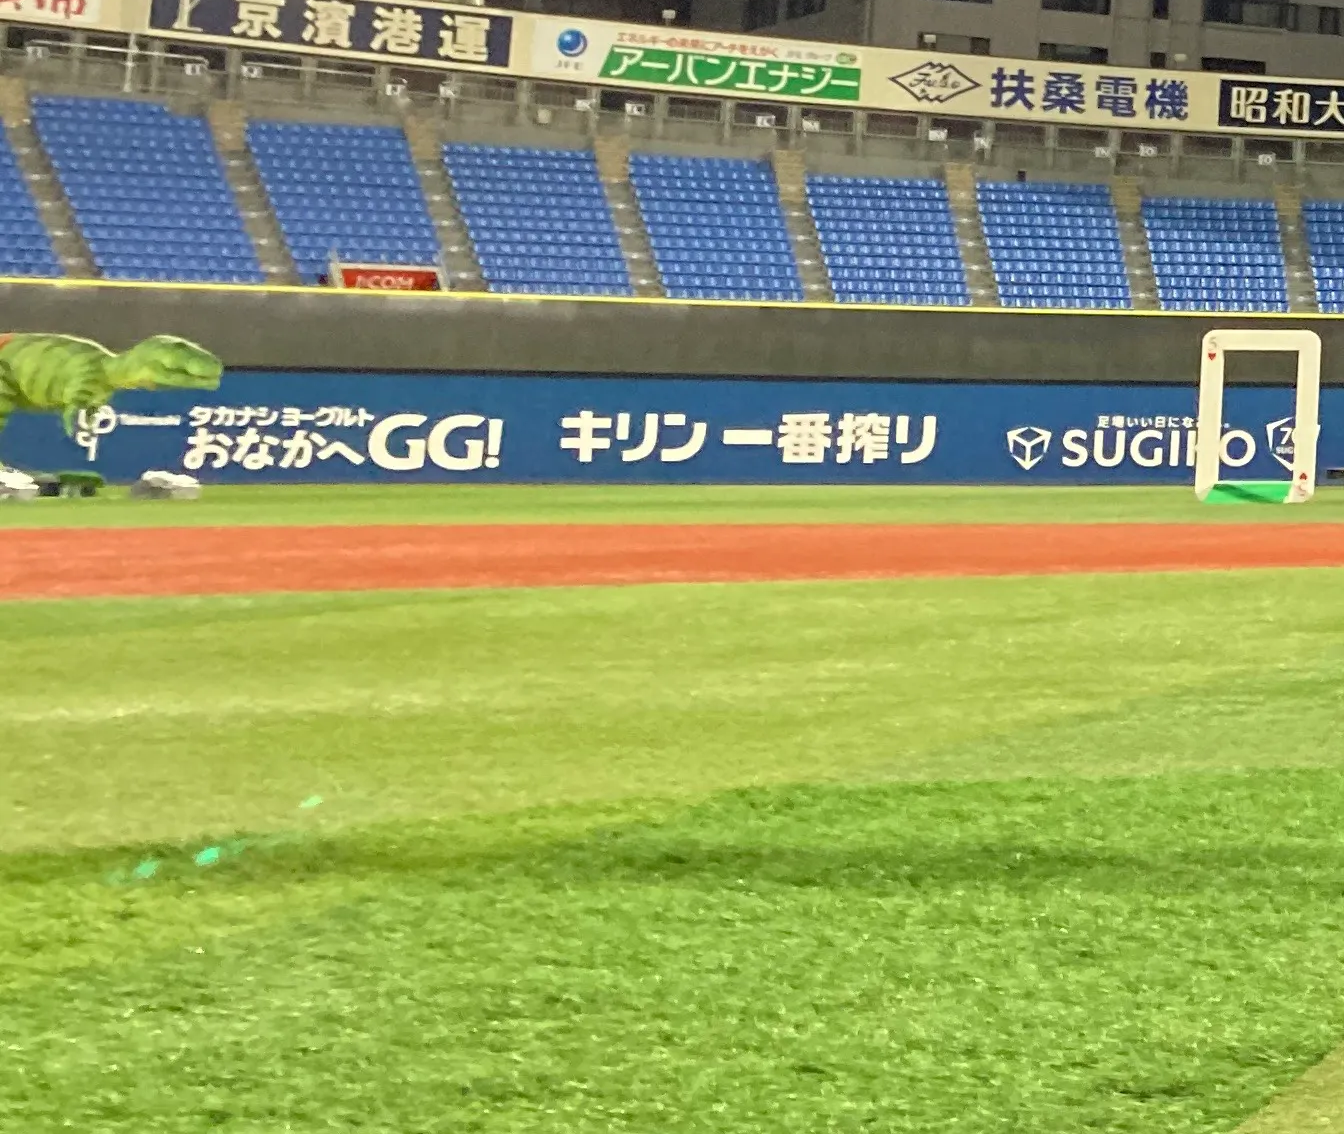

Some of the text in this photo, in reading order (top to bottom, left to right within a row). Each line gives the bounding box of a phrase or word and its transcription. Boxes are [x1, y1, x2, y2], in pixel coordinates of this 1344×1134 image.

[610, 46, 860, 95] アーバンエナジー
[560, 411, 937, 464] キリン一番搾り
